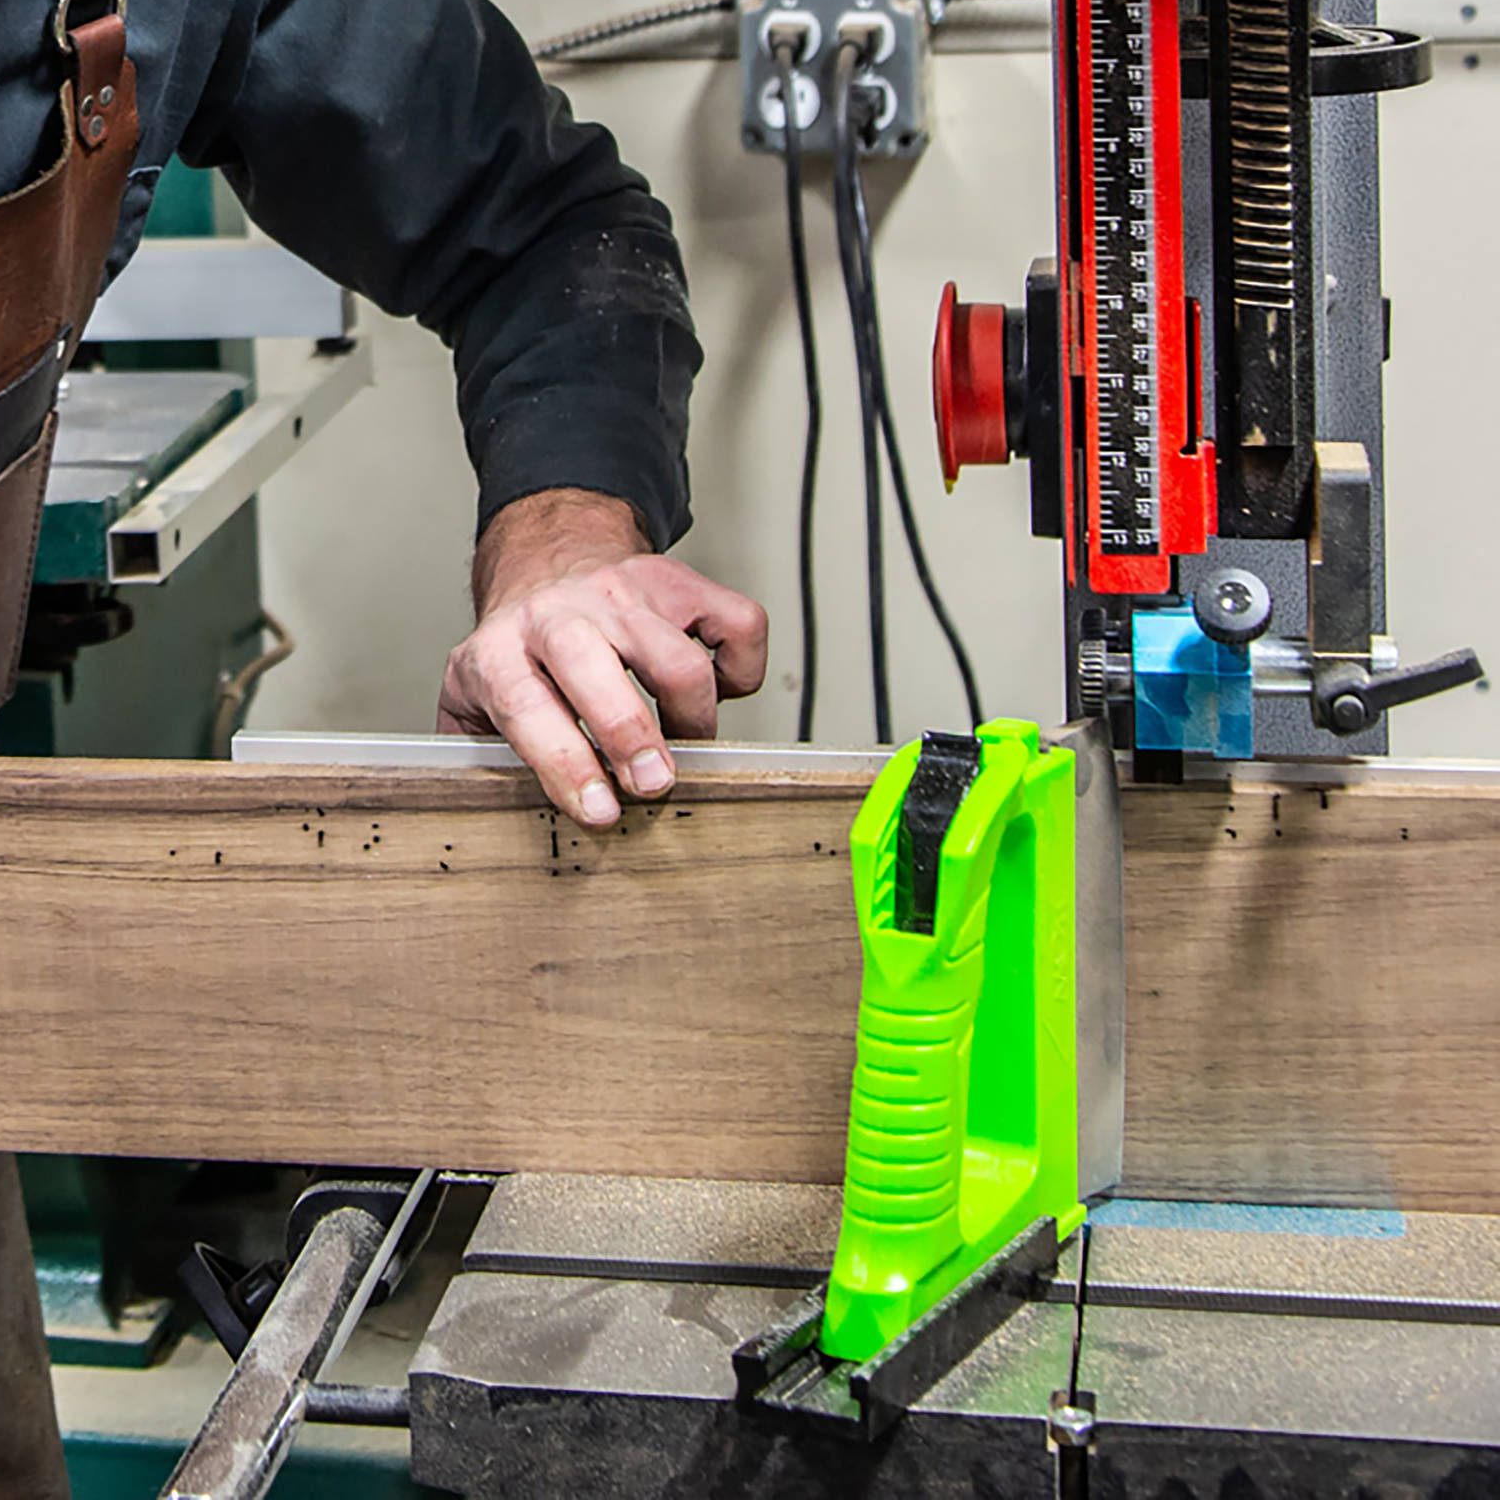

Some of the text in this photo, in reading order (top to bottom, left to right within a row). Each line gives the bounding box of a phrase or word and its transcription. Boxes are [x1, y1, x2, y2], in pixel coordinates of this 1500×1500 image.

[1128, 38, 1141, 49] 17
[1108, 63, 1115, 75] 7
[1128, 101, 1142, 112] 19
[1128, 132, 1143, 143] 20
[1129, 163, 1143, 174] 21
[1129, 194, 1144, 205] 22
[1130, 224, 1145, 236] 23
[1131, 287, 1146, 299] 25
[1109, 300, 1124, 310] 10
[1132, 350, 1147, 360] 27
[1110, 378, 1124, 388] 11
[1133, 411, 1149, 422] 29
[1134, 442, 1149, 452] 30
[1112, 456, 1127, 467] 12
[1134, 472, 1149, 483] 31
[1135, 503, 1150, 514] 32
[1113, 534, 1129, 545] 13
[1136, 534, 1151, 545] 33
